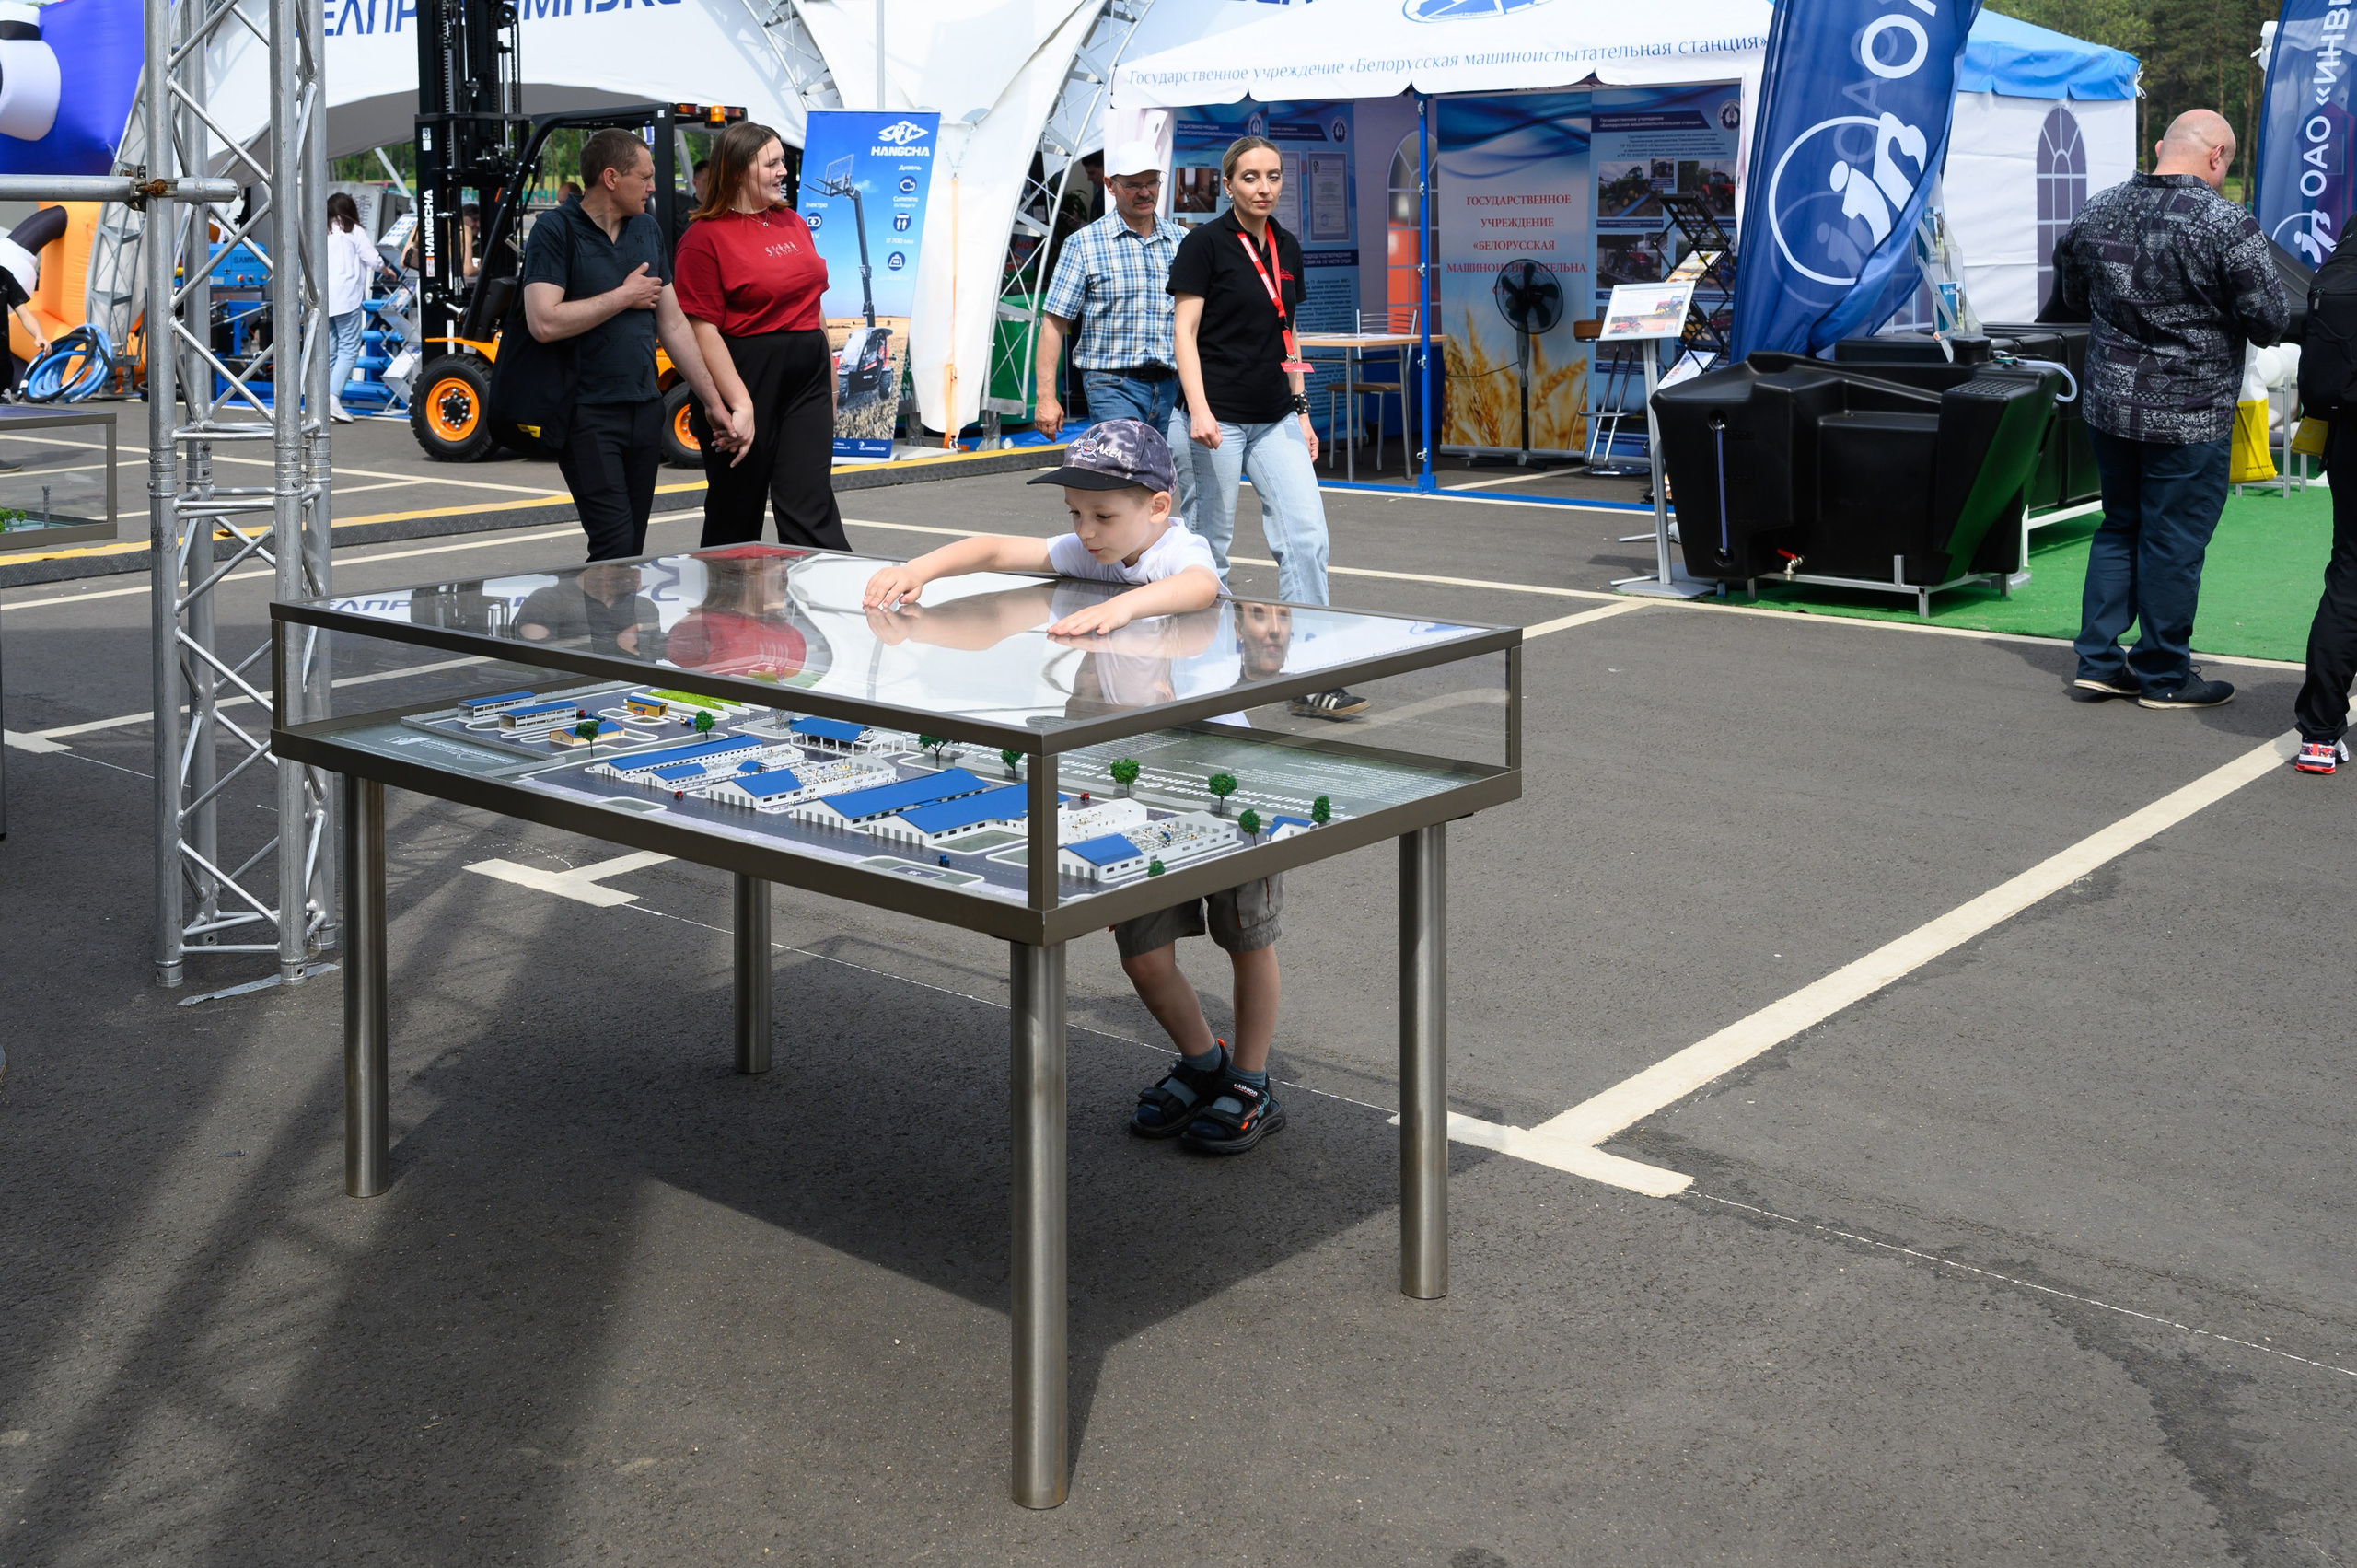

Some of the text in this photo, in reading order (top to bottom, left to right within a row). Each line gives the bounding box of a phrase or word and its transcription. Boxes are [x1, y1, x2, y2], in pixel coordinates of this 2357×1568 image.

[1129, 34, 1768, 86] Государственное учреждение «Белорусская машиноиспытательная станция»
[2300, 0, 2351, 197] ОАО «ИНВ
[870, 146, 930, 157] HANGCHA
[1466, 194, 1572, 206] ГОСУДАРСТВЕННОЕ
[424, 189, 435, 256] HANGCHA
[1480, 217, 1554, 228] УЧРЕЖДЕНИЕ
[1473, 239, 1555, 250] «БЕЛОРУССКАЯ
[1097, 443, 1122, 460] AREA
